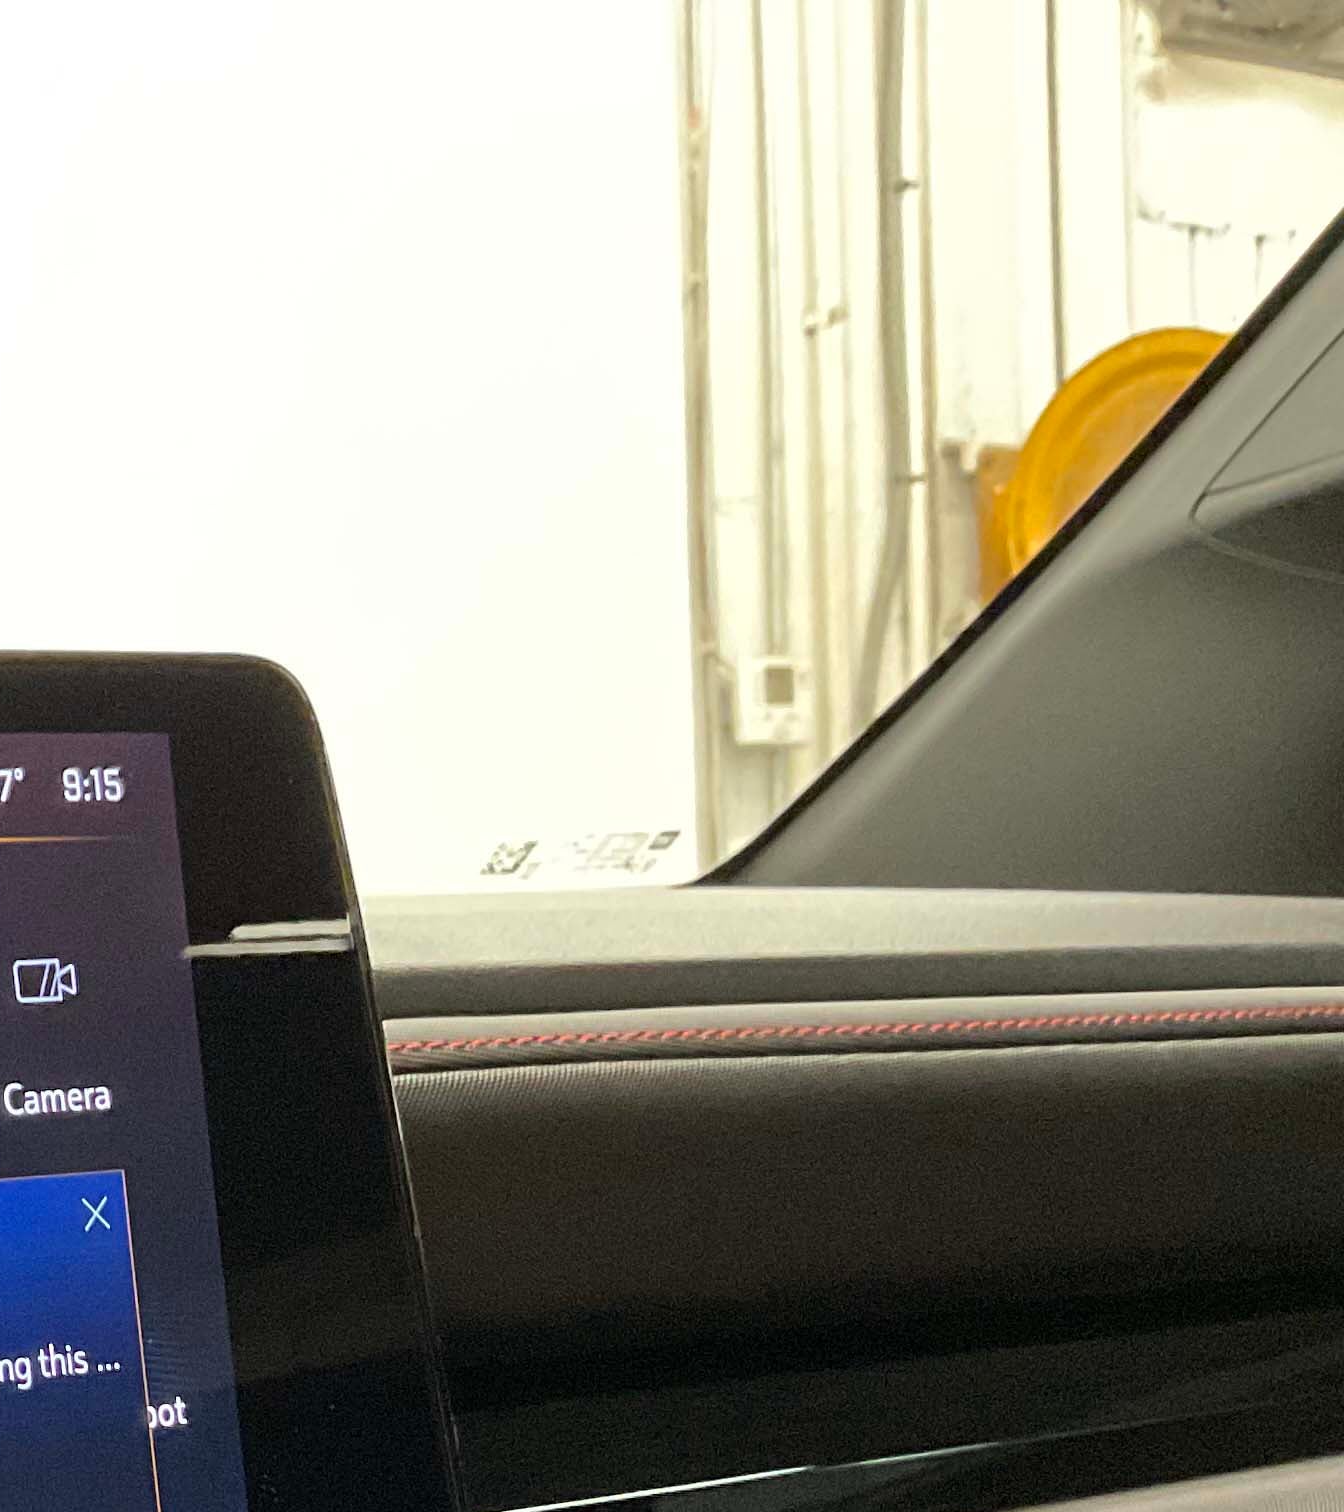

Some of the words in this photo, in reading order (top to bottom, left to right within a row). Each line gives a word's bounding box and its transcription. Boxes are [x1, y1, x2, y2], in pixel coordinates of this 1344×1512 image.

[63, 767, 123, 801] 9:15
[4, 1083, 111, 1116] Camera
[38, 1343, 88, 1378] this
